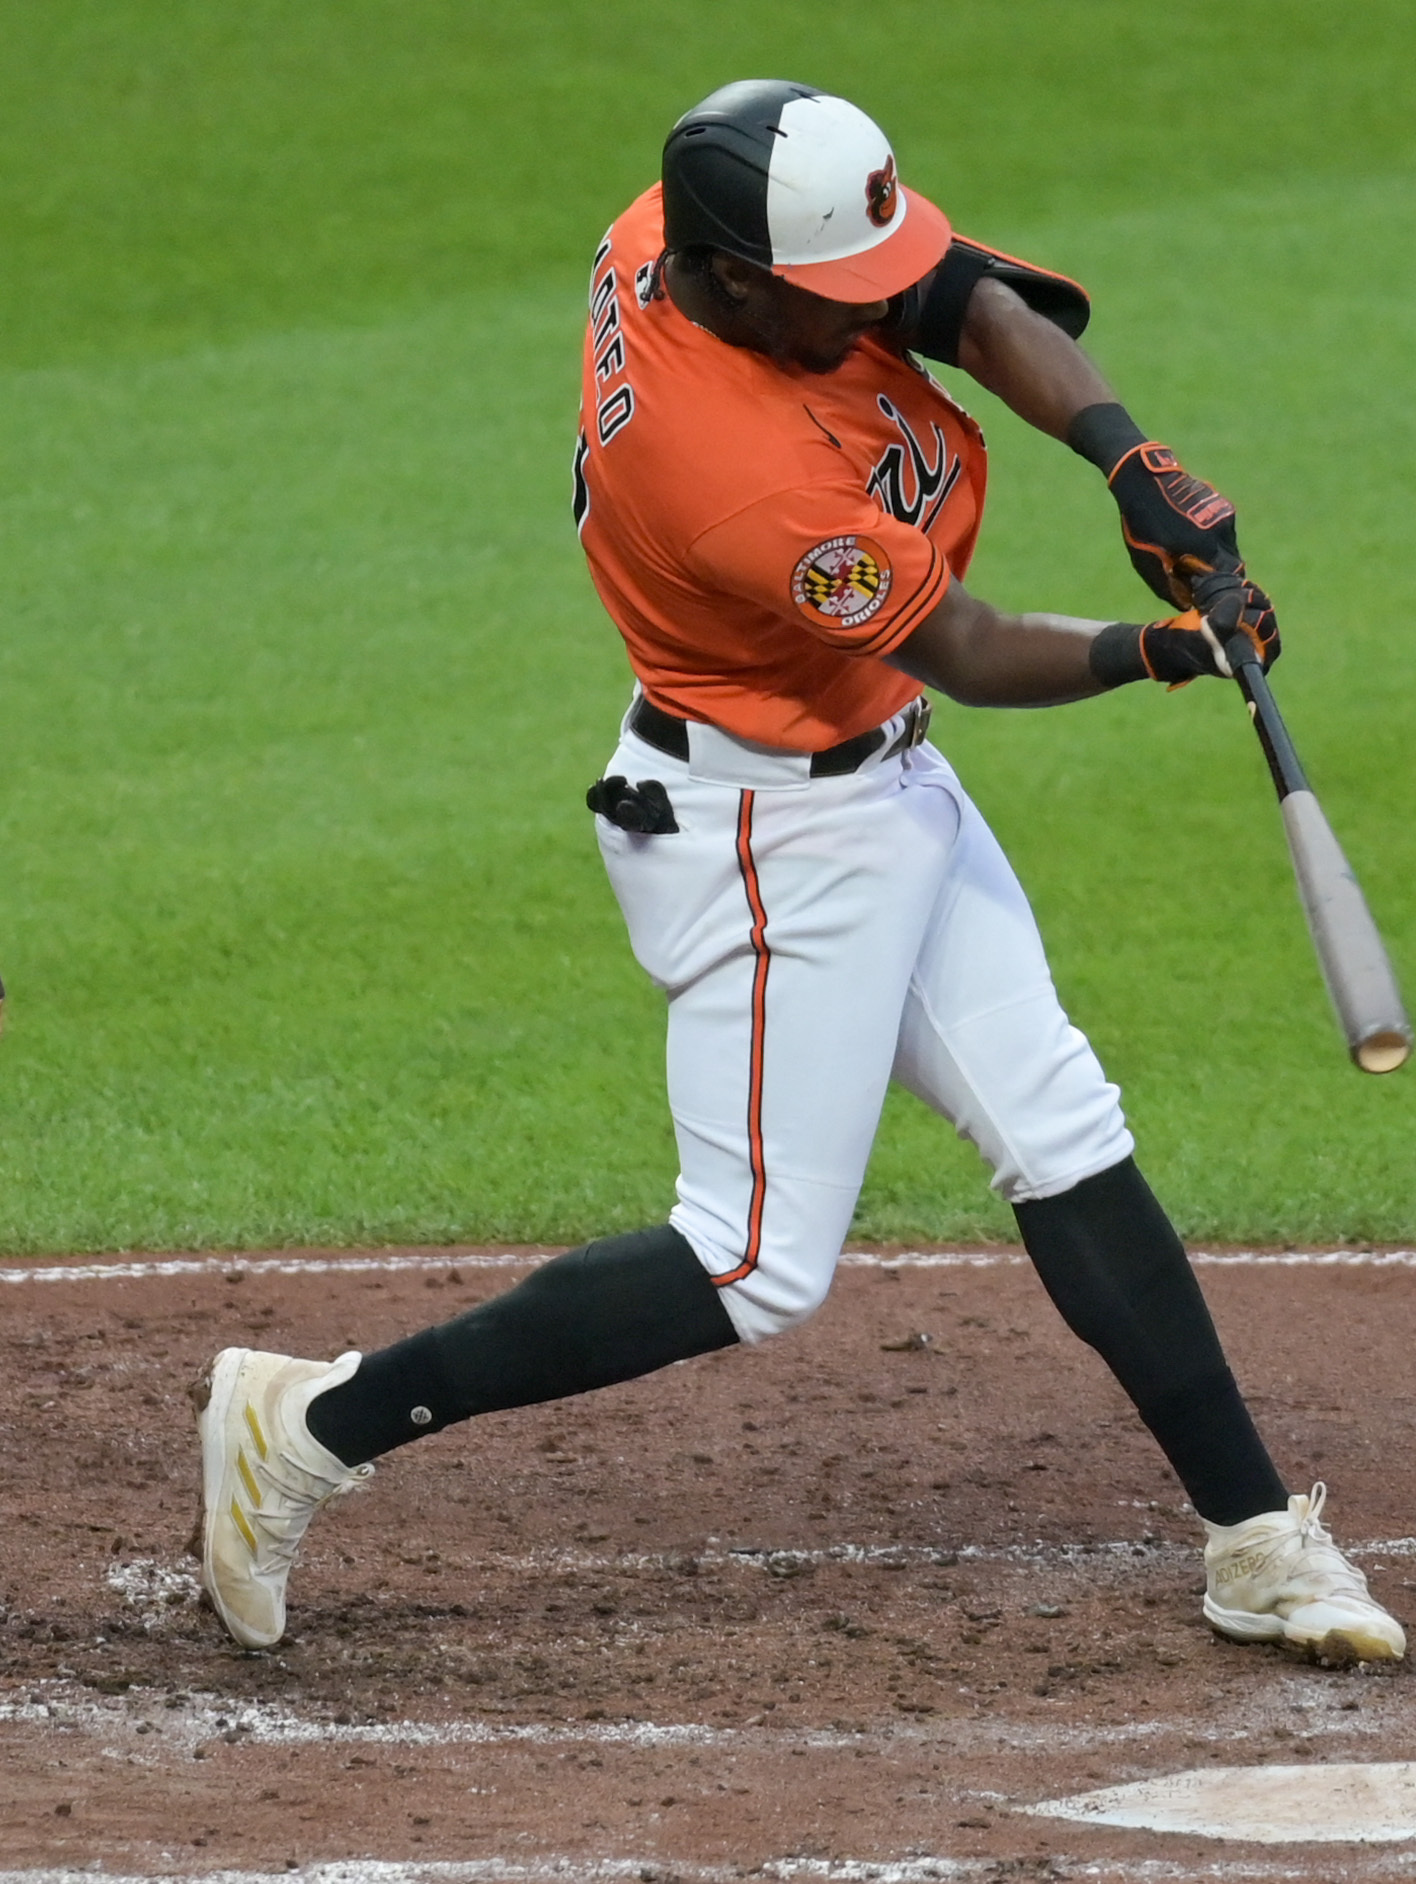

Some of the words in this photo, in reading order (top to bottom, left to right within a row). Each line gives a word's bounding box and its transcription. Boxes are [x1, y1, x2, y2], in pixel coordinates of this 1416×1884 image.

[590, 226, 635, 447] ATEO
[793, 536, 857, 604] BALTIMORE
[841, 569, 891, 626] ORIOLES
